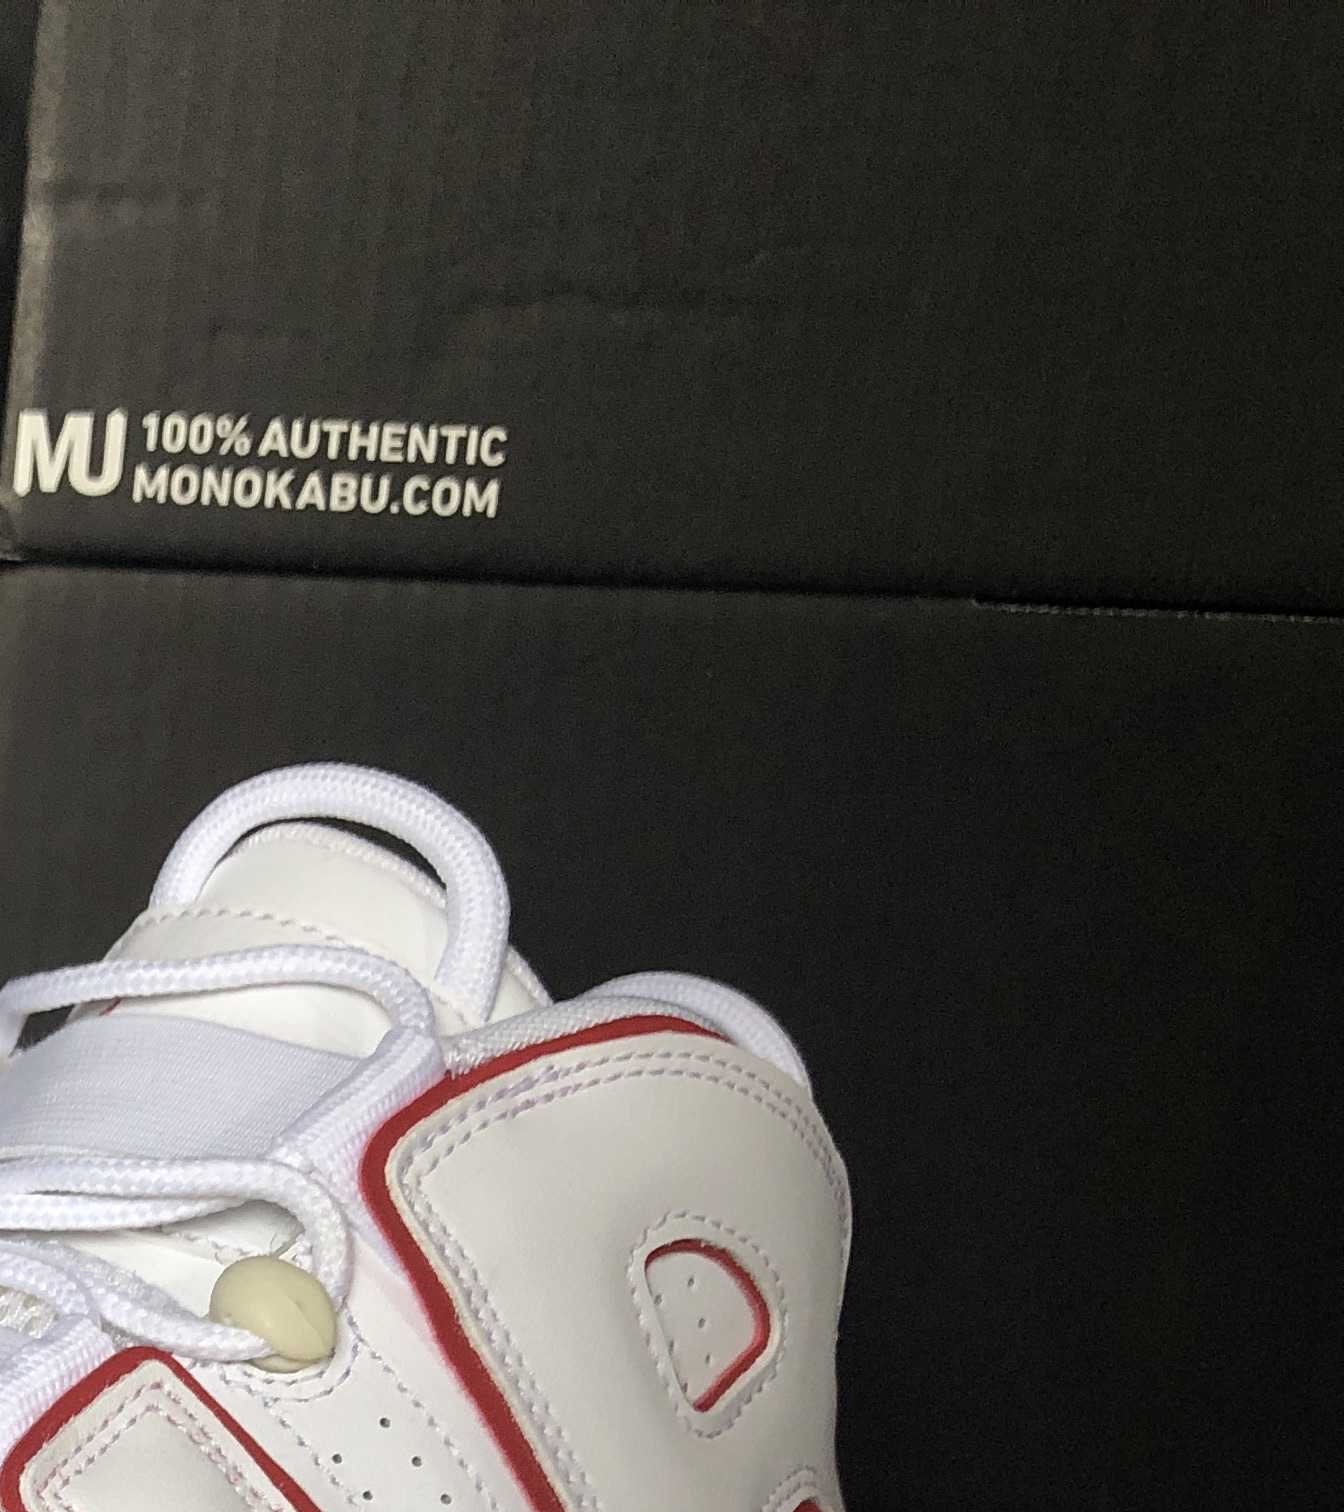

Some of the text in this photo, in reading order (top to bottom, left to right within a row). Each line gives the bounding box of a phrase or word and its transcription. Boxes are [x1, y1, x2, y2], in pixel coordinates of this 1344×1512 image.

[12, 407, 128, 498] MU
[141, 409, 509, 468] 100% AUTHENTIC
[131, 462, 502, 519] MONOKABU.COM
